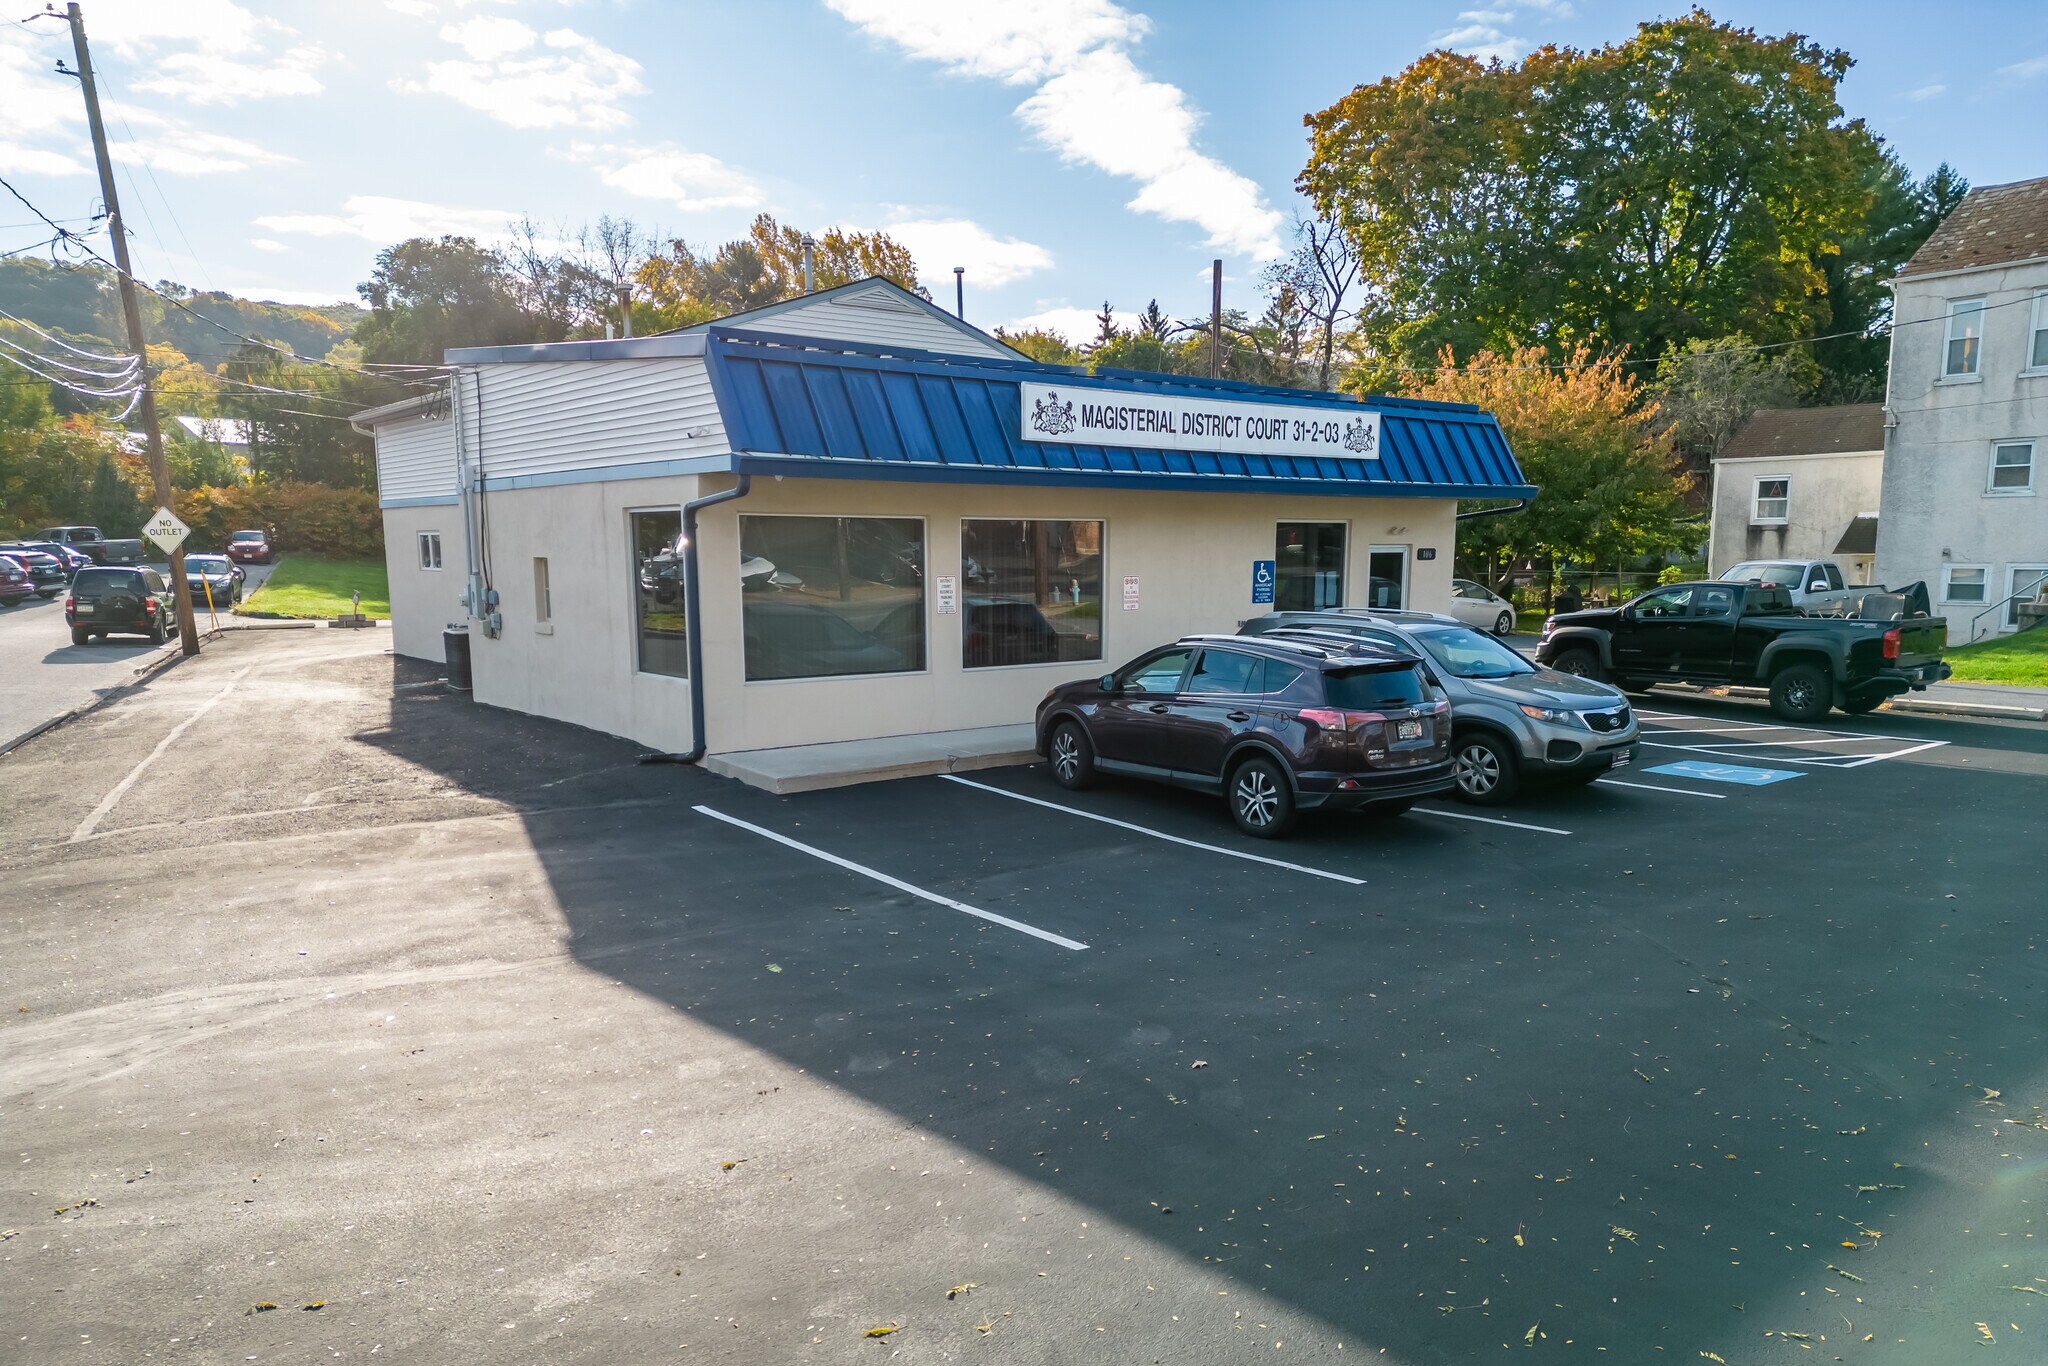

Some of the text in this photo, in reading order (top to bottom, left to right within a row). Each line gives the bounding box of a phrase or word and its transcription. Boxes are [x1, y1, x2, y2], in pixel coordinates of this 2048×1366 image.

[1081, 404, 1340, 444] MAGISTERIAL DISTRICT COURT 31-2-03
